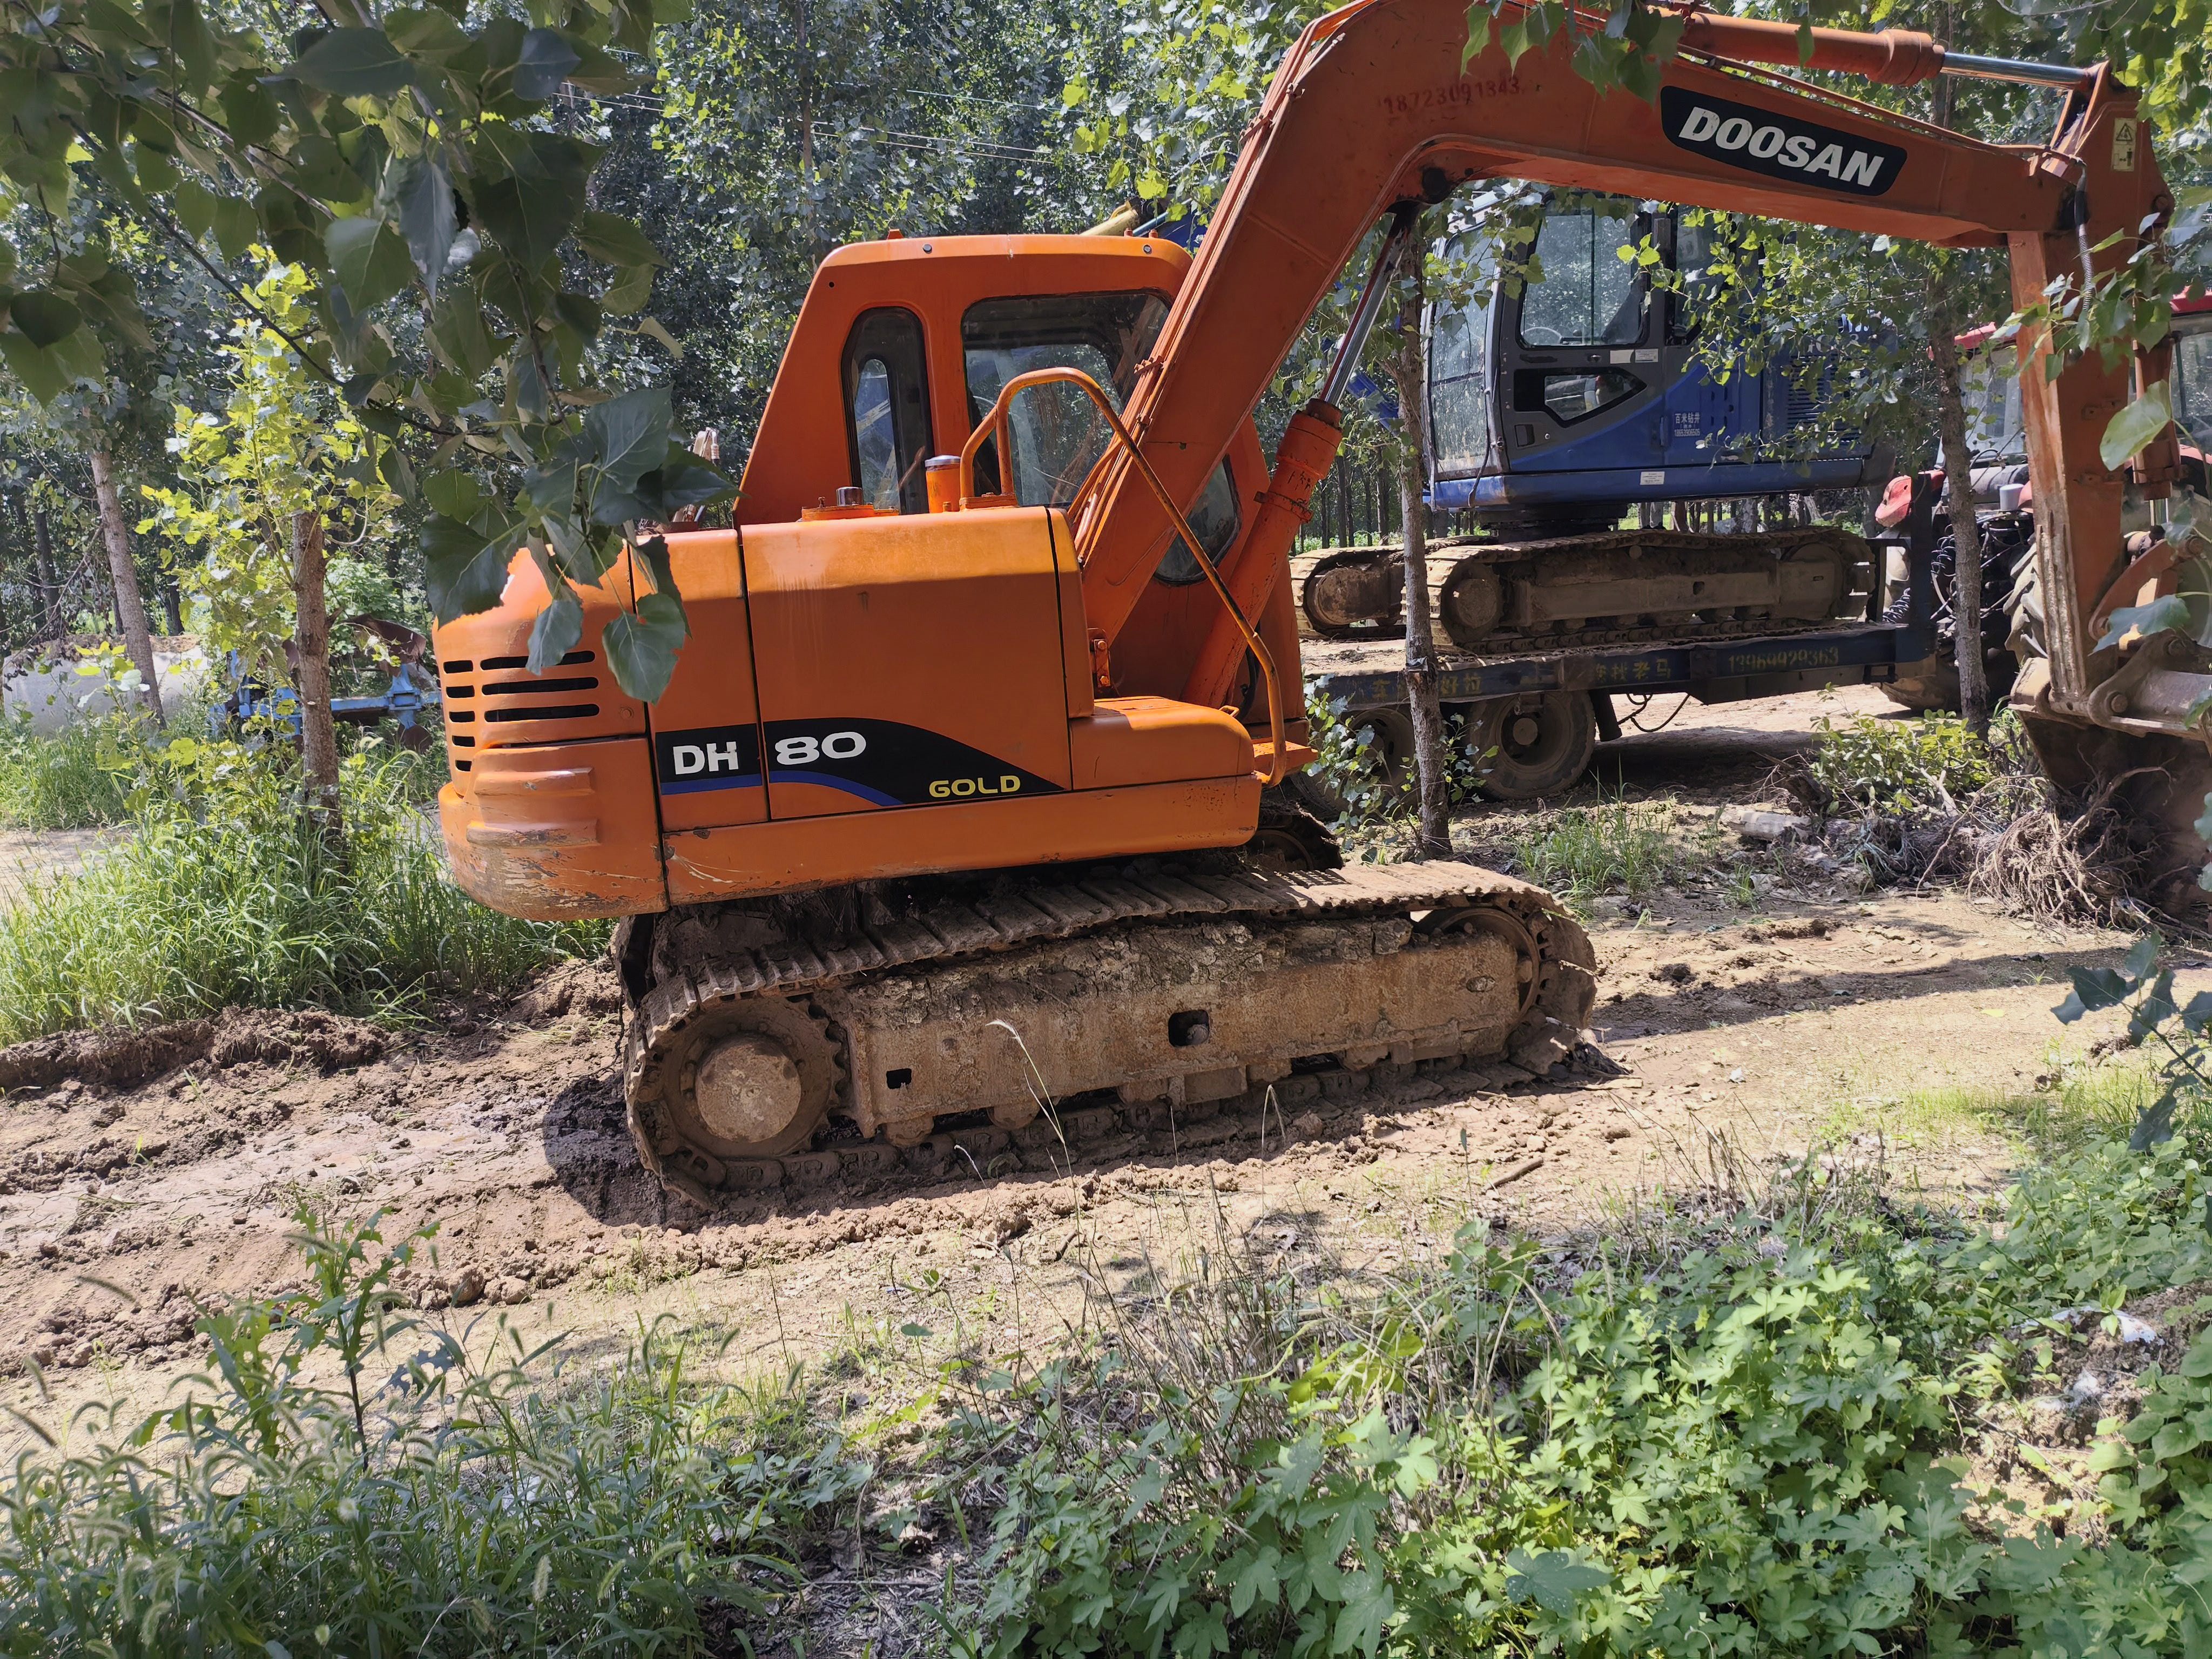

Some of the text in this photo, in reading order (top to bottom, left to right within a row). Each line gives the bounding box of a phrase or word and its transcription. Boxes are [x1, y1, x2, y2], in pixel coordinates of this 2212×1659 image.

[1678, 106, 1885, 187] DOOSAN
[1675, 412, 1700, 424] 百米钻井
[673, 731, 867, 775] DH 80
[929, 775, 1021, 798] GOLD
